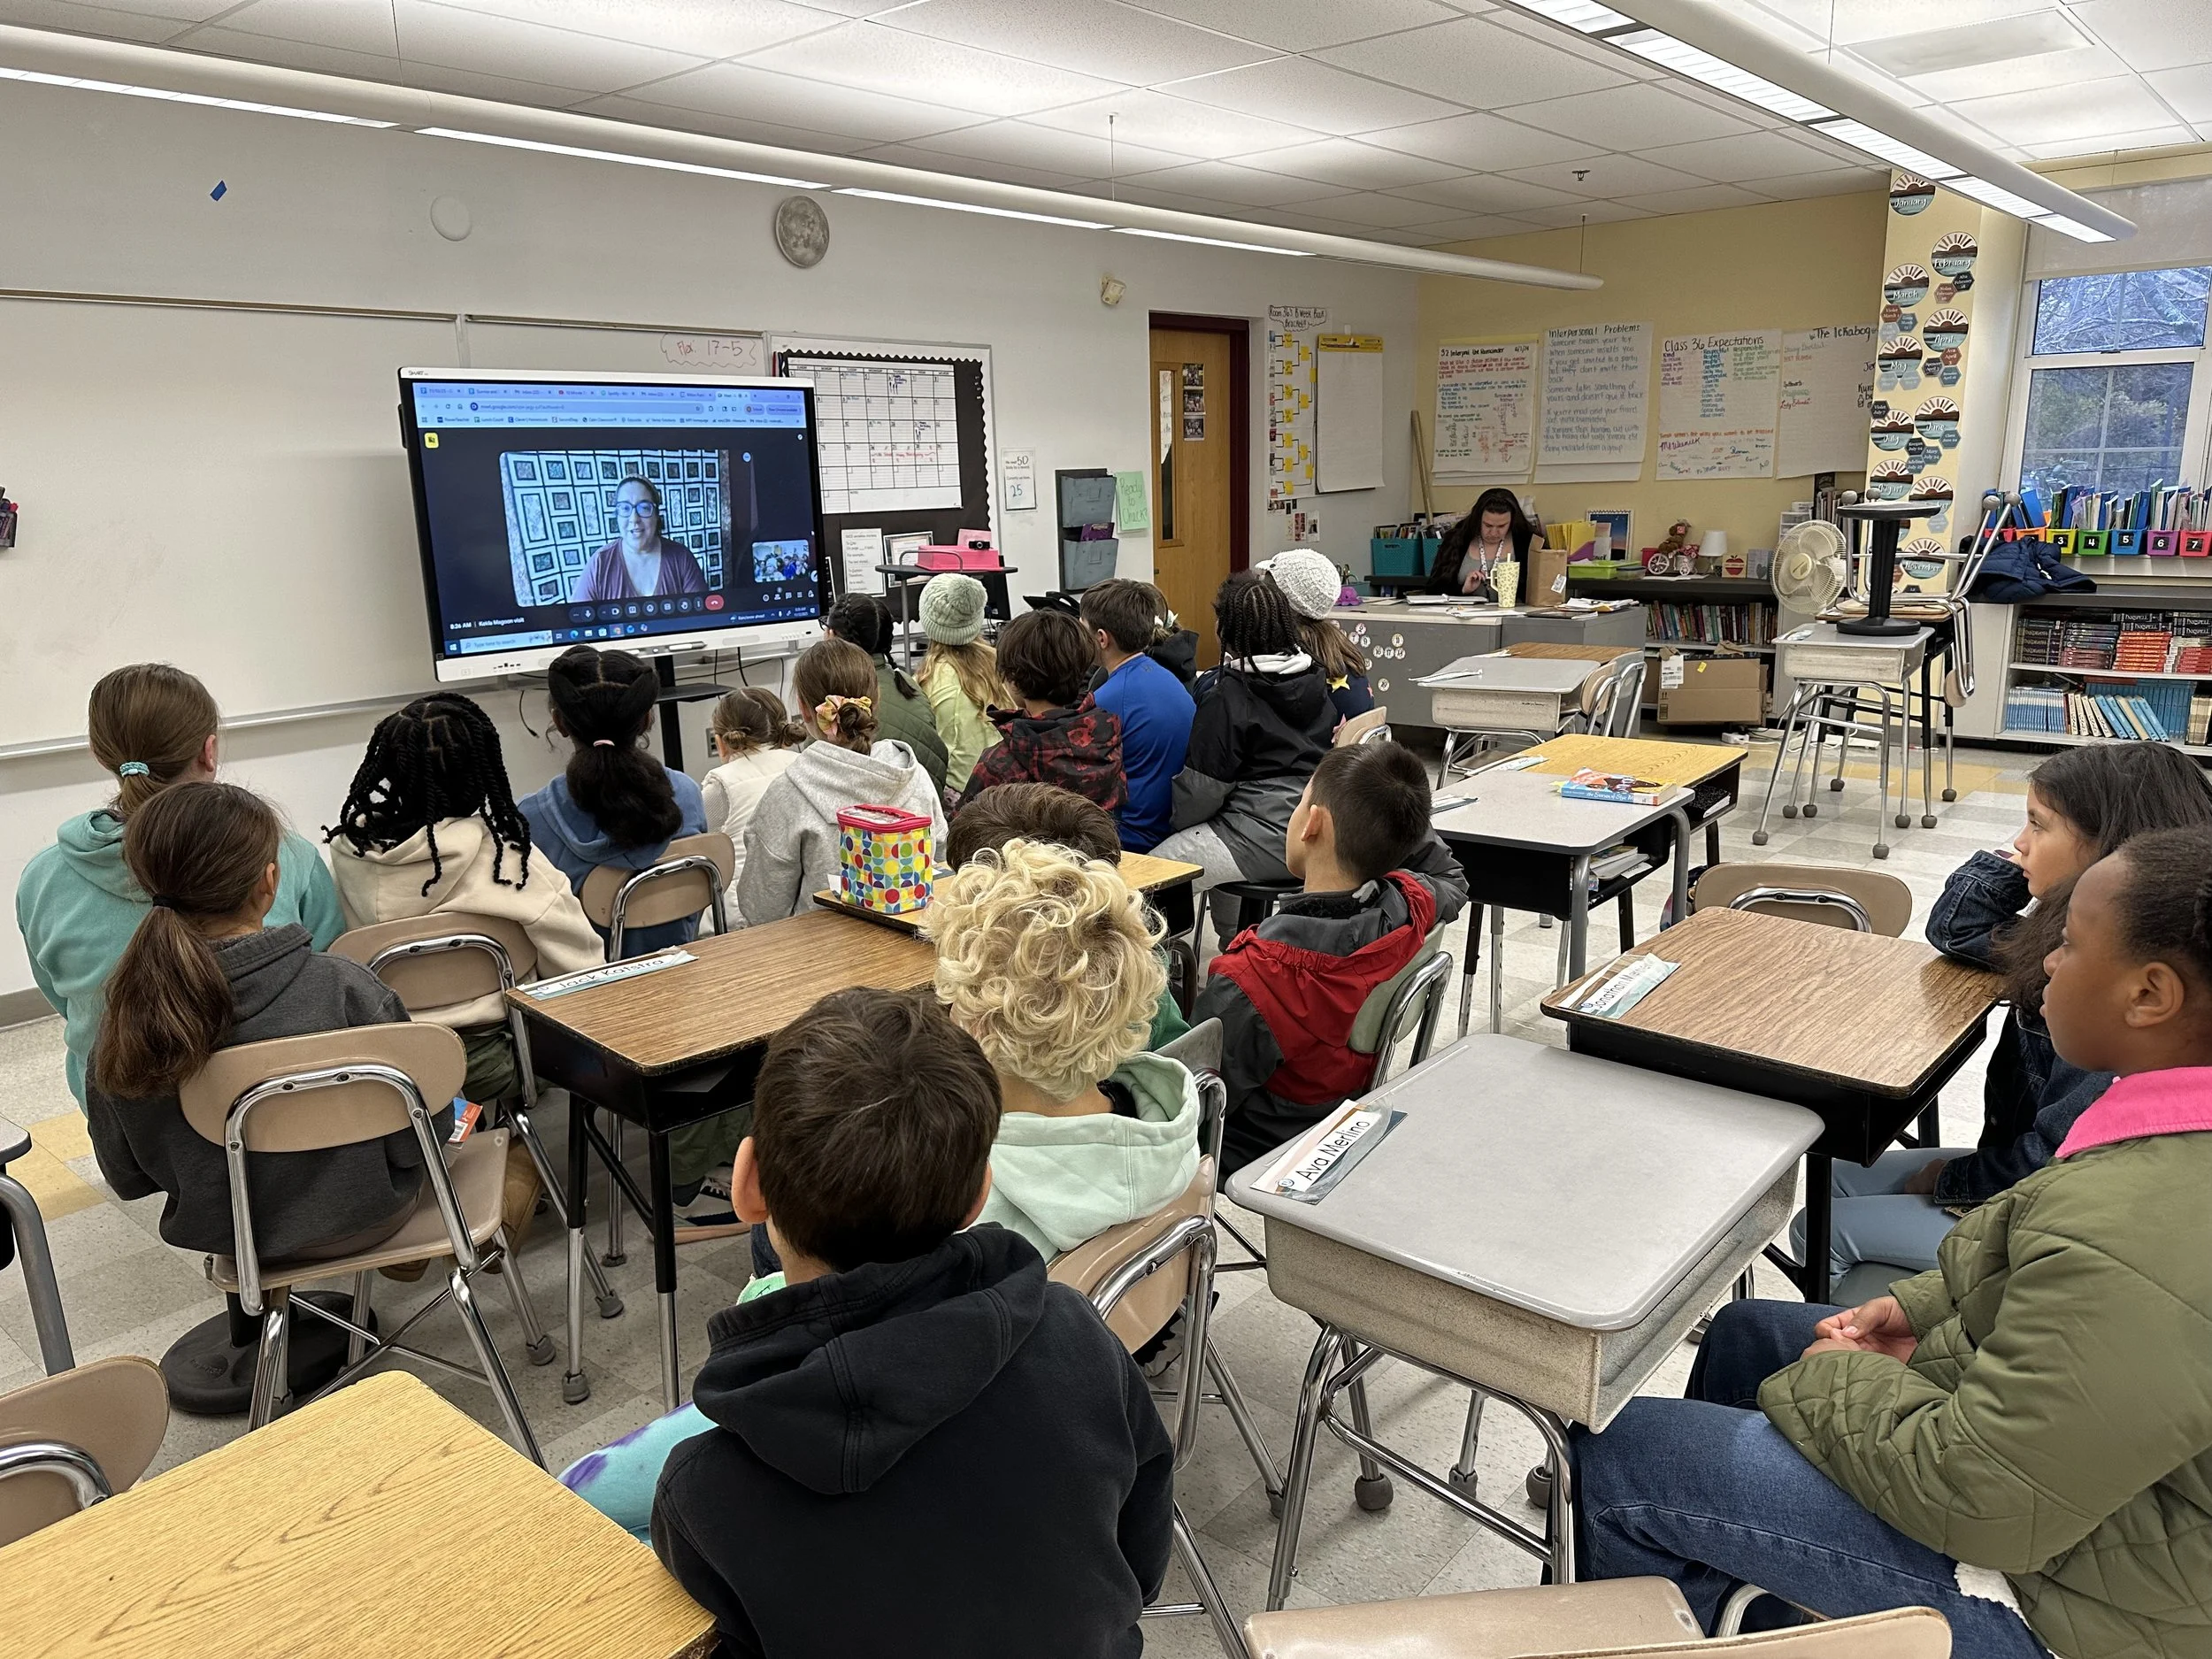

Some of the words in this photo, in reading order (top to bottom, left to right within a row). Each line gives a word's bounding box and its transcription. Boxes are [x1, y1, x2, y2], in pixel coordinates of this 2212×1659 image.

[1895, 197, 1928, 208] January
[1934, 257, 1971, 270] February
[1893, 289, 1919, 299] March
[1549, 326, 1598, 338] Interpersonal
[1604, 324, 1641, 334] Problems
[1813, 326, 1830, 339] The
[1664, 340, 1688, 352] Class
[1708, 335, 1764, 349] Expectations
[1934, 334, 1955, 346] April
[708, 339, 743, 357] 17-5
[1890, 361, 1908, 373] May
[1925, 422, 1945, 431] June
[1883, 434, 1900, 446] July
[1017, 456, 1029, 466] 50
[1010, 484, 1023, 497] 25
[1119, 477, 1142, 498] Ready
[1128, 495, 1135, 506] to
[2087, 538, 2095, 547] 4
[1905, 562, 1939, 572] November
[559, 973, 600, 988] Jack
[602, 959, 664, 977] Katstra
[1594, 981, 1626, 1010] Jonathan
[1295, 1155, 1329, 1181] Ava
[1317, 1120, 1371, 1157] Merlino
